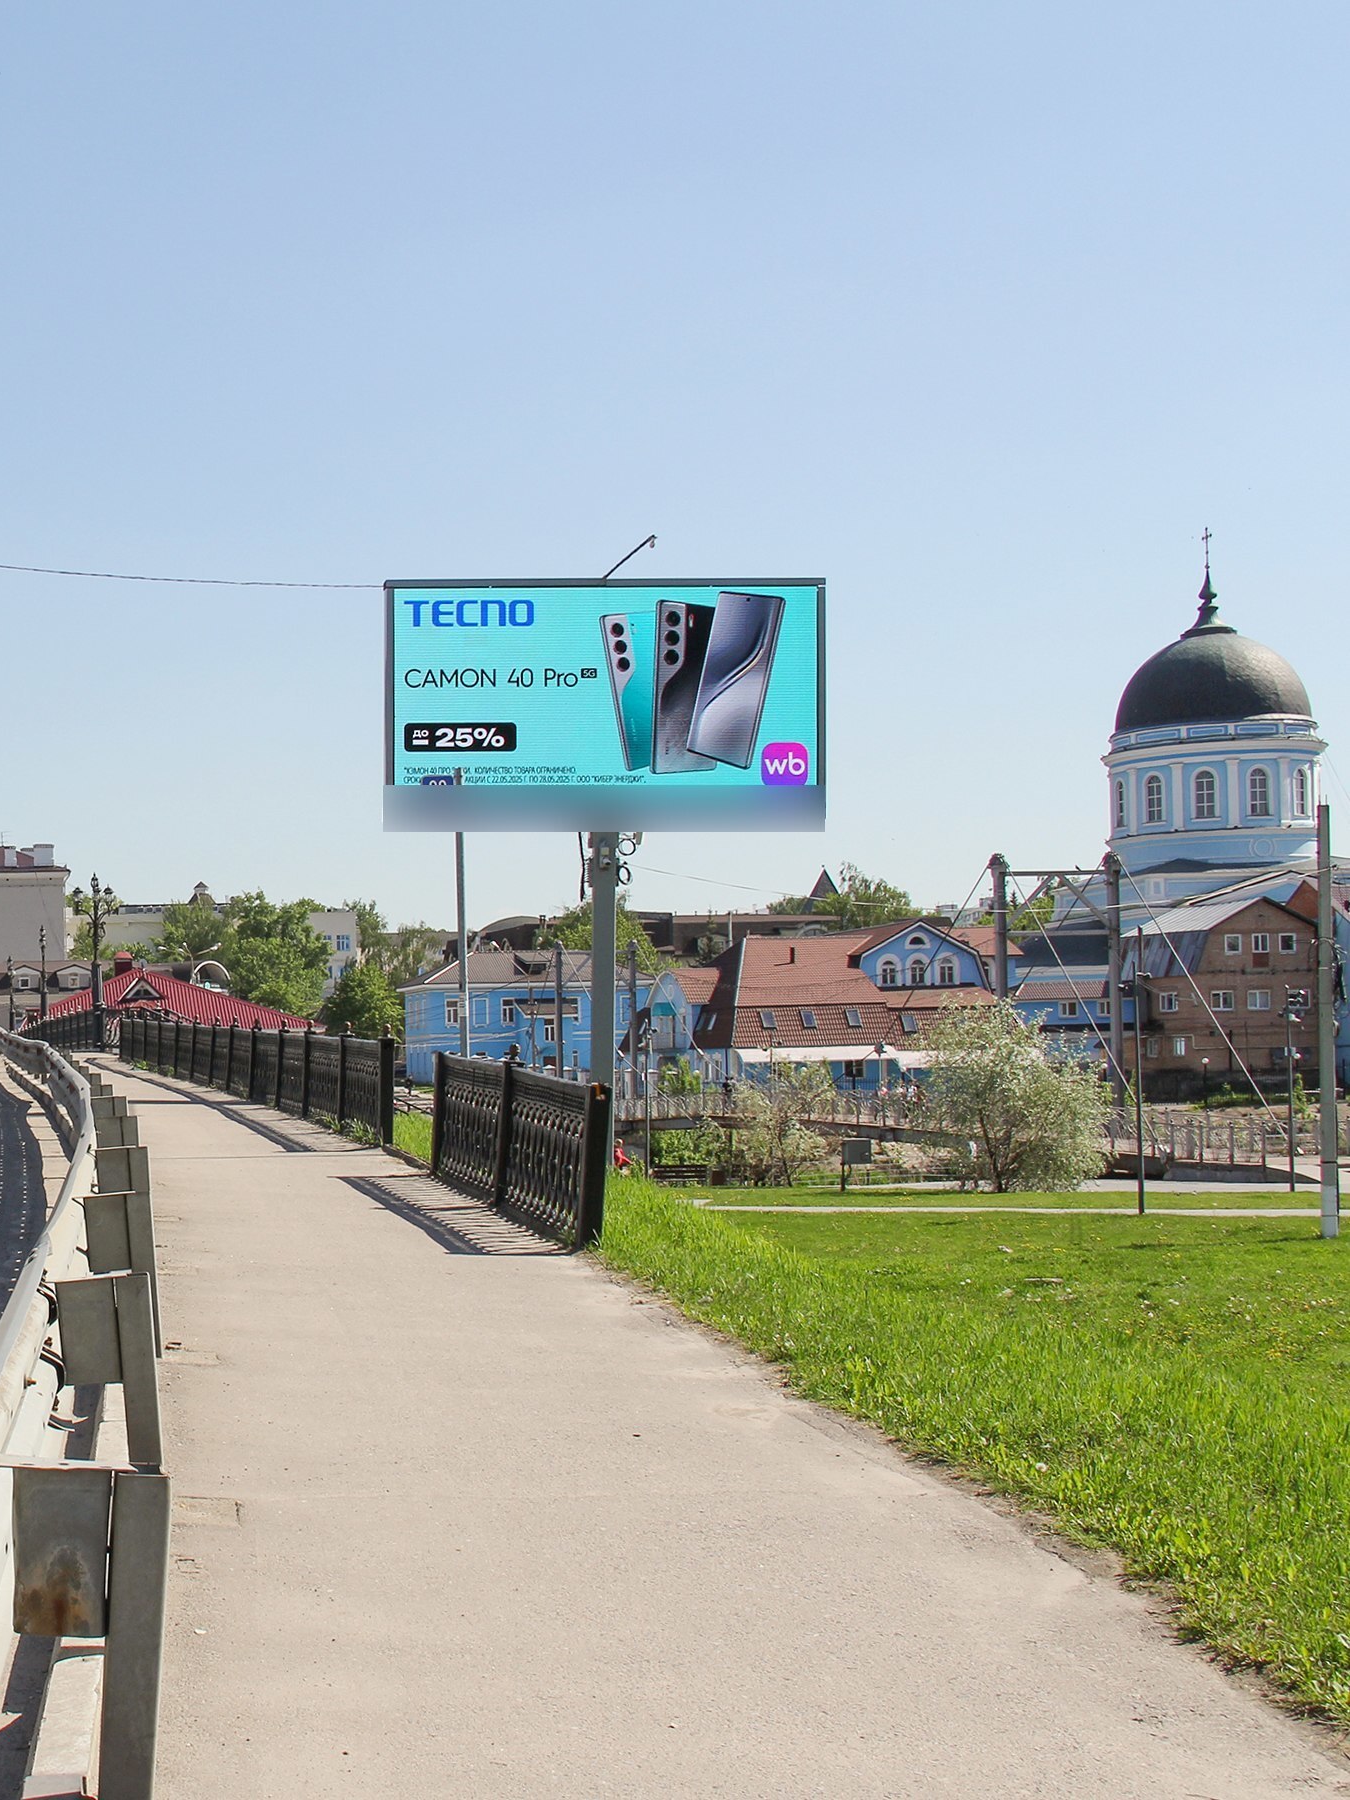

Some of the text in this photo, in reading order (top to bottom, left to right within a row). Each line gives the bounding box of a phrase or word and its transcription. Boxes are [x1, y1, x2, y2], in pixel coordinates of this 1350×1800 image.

[404, 599, 534, 627] TECNO
[404, 668, 596, 688] CAMON 40 Pro 5G
[412, 727, 505, 748] до 25%
[475, 766, 513, 775] КОЛИЧЕСТВО
[514, 766, 535, 775] ТОВАРА
[764, 752, 806, 776] wb
[529, 776, 539, 784] ПО
[576, 775, 590, 784] ООО
